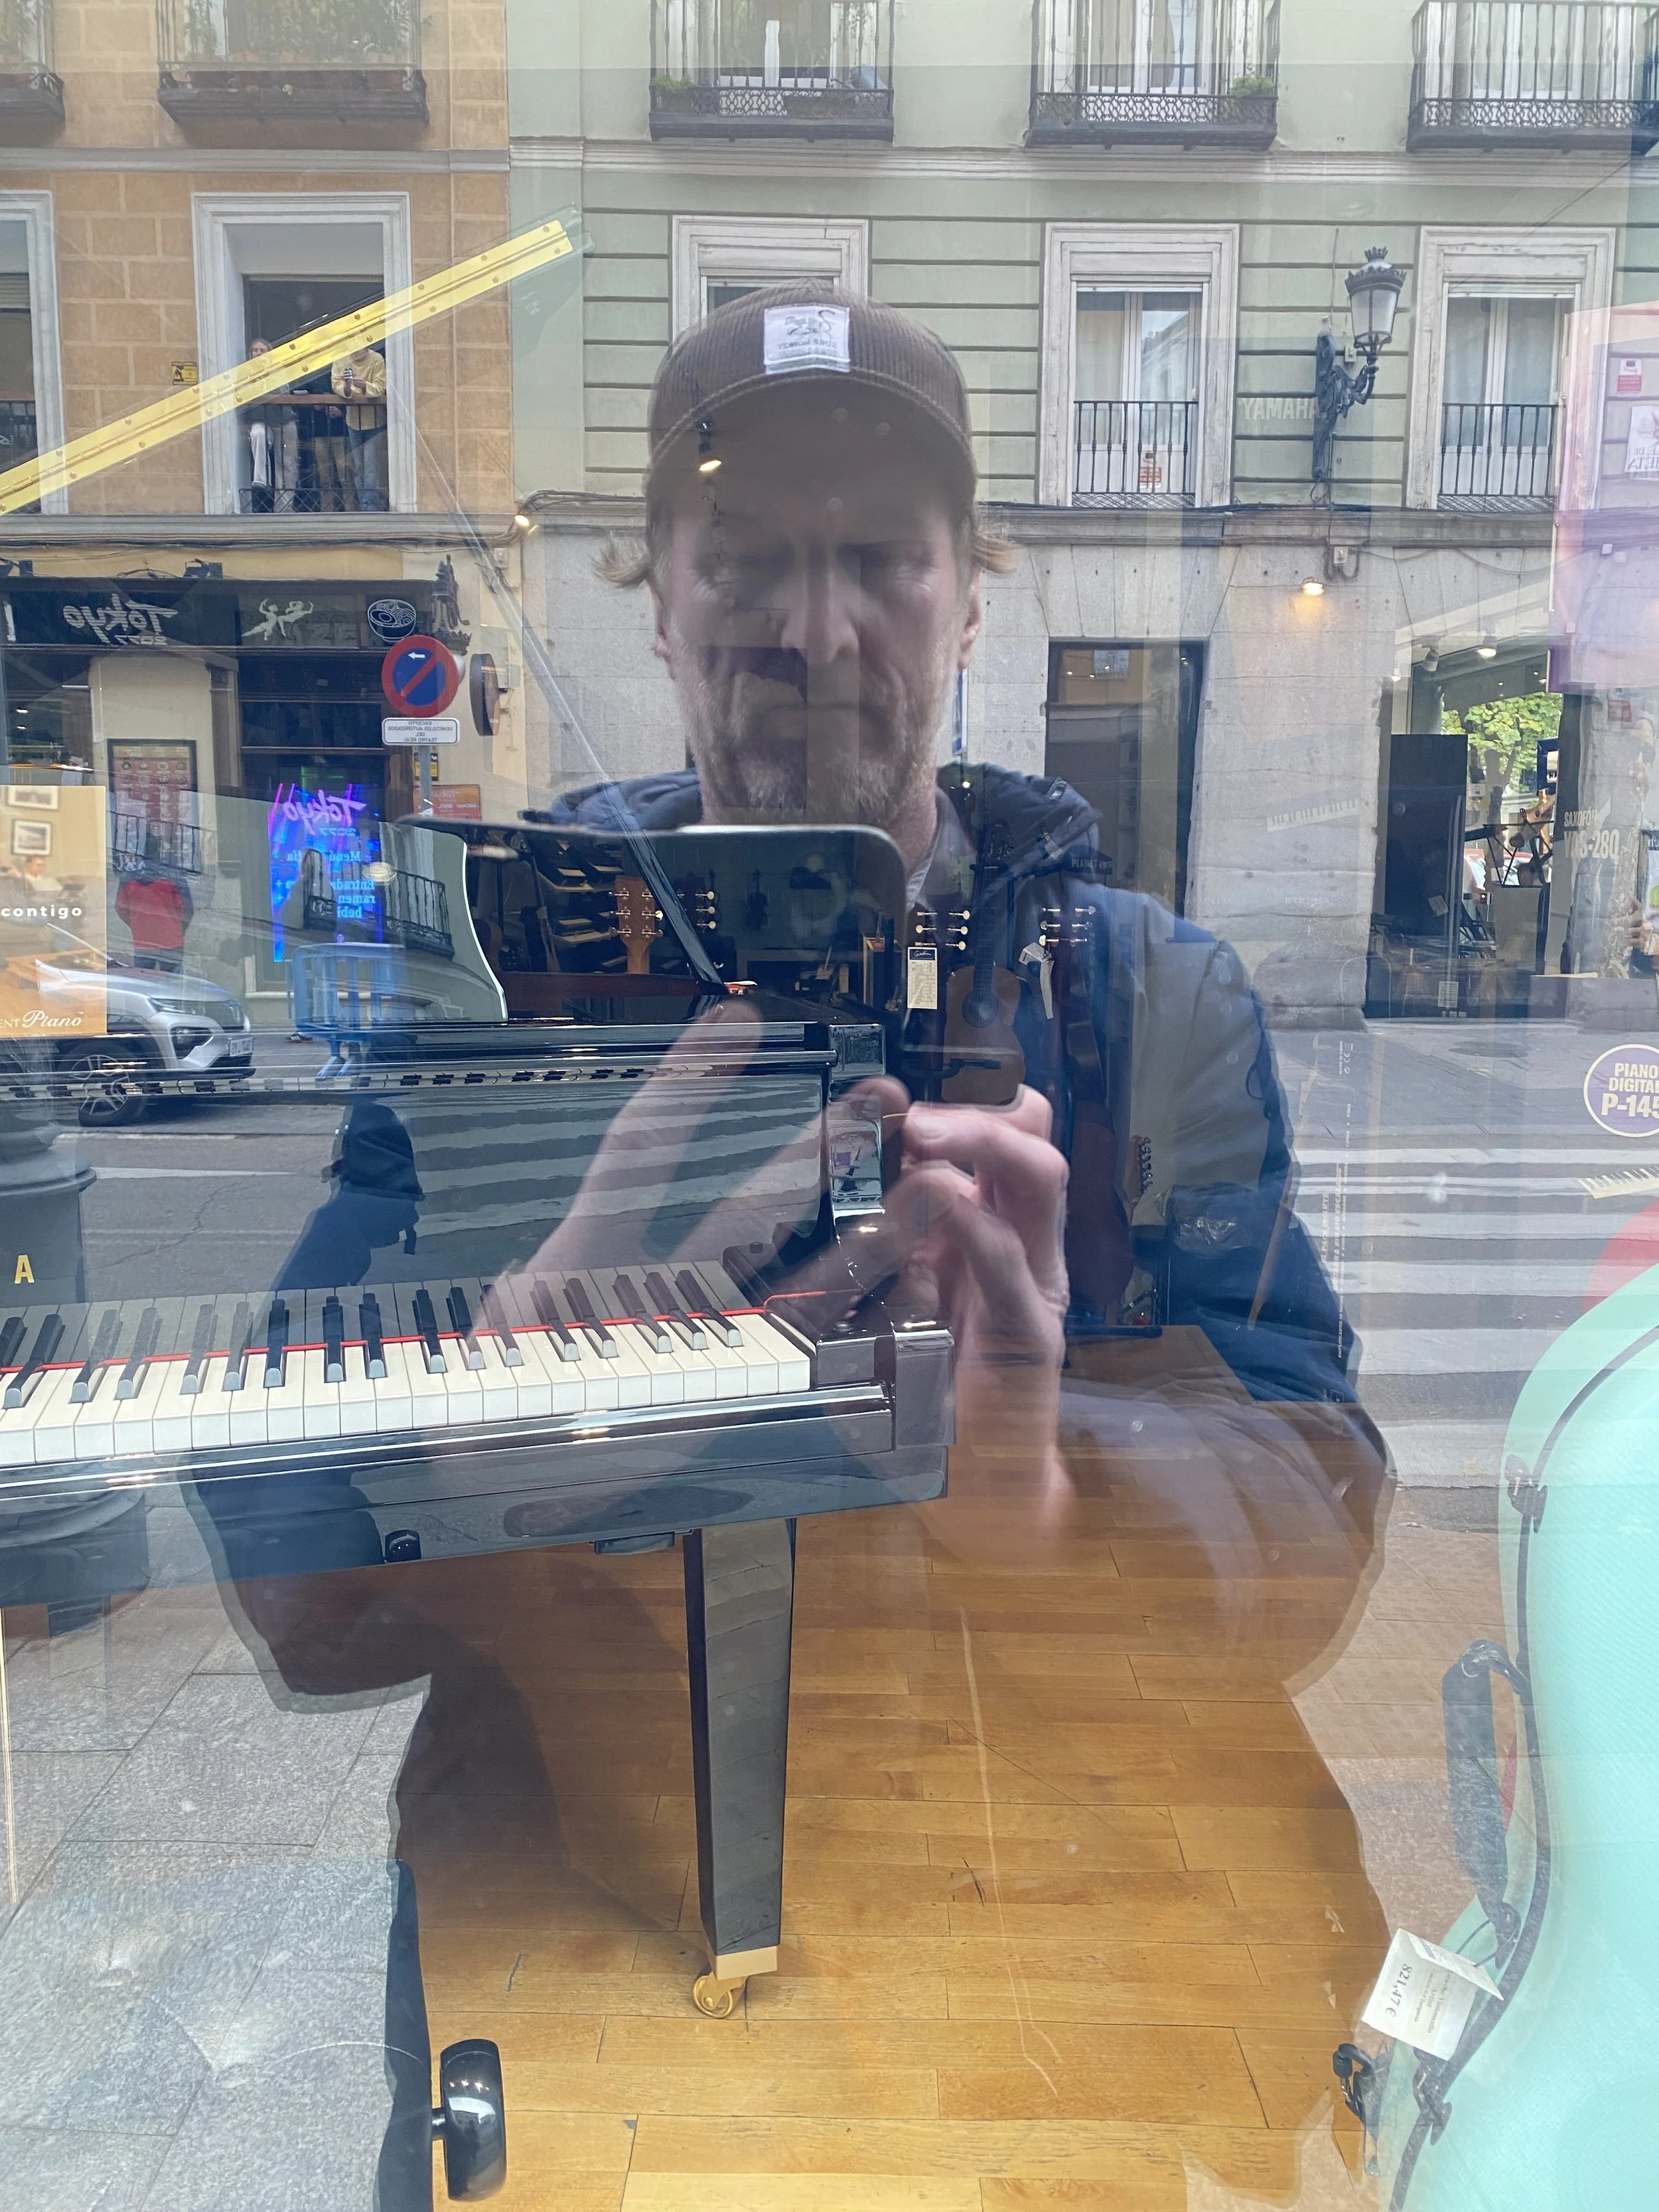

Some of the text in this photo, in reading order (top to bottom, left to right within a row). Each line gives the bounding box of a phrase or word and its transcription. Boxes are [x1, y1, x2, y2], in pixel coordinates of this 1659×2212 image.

[1242, 398, 1320, 419] YAMAHA
[0, 905, 82, 921] contigo
[21, 1009, 82, 1028] Piano
[1615, 1063, 1659, 1078] PIANO
[14, 1254, 35, 1284] A
[1386, 1963, 1413, 2018] 821,47 €
